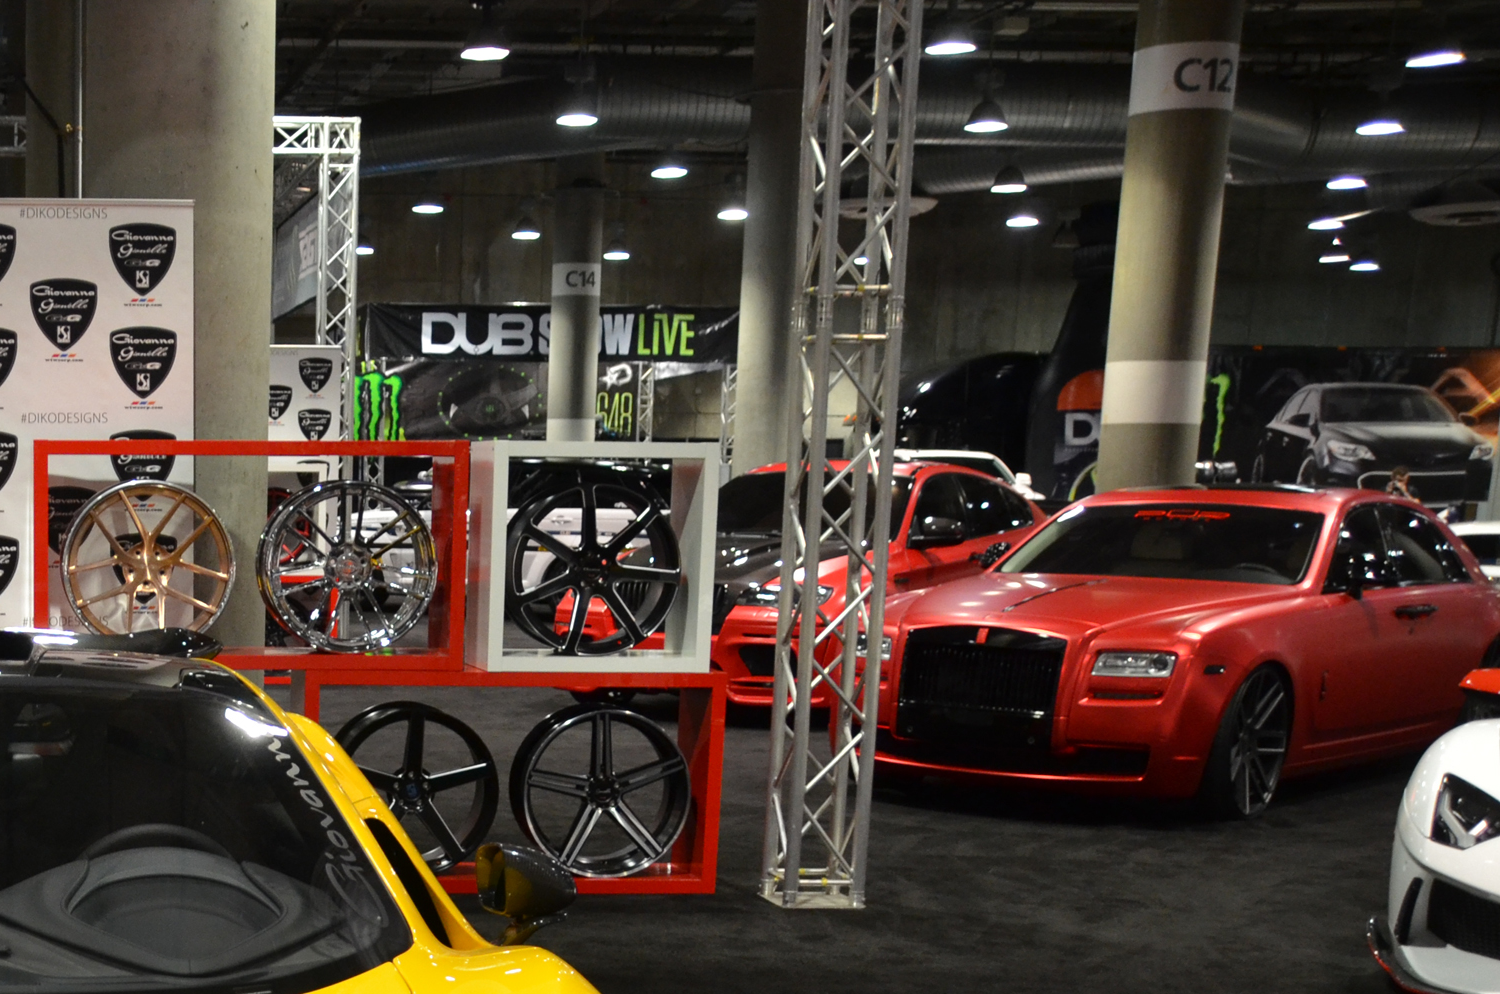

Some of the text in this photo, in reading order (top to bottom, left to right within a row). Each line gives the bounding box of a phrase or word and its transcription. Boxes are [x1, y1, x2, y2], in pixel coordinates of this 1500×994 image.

[1173, 57, 1234, 93] C12
[19, 207, 108, 220] #DIKODESIGNS
[111, 229, 174, 241] Giovanna
[565, 270, 596, 288] C14
[32, 285, 95, 296] Giovanna
[112, 333, 175, 344] Giovanna
[421, 312, 533, 355] DUB
[20, 412, 108, 424] #DIKODESIGNS
